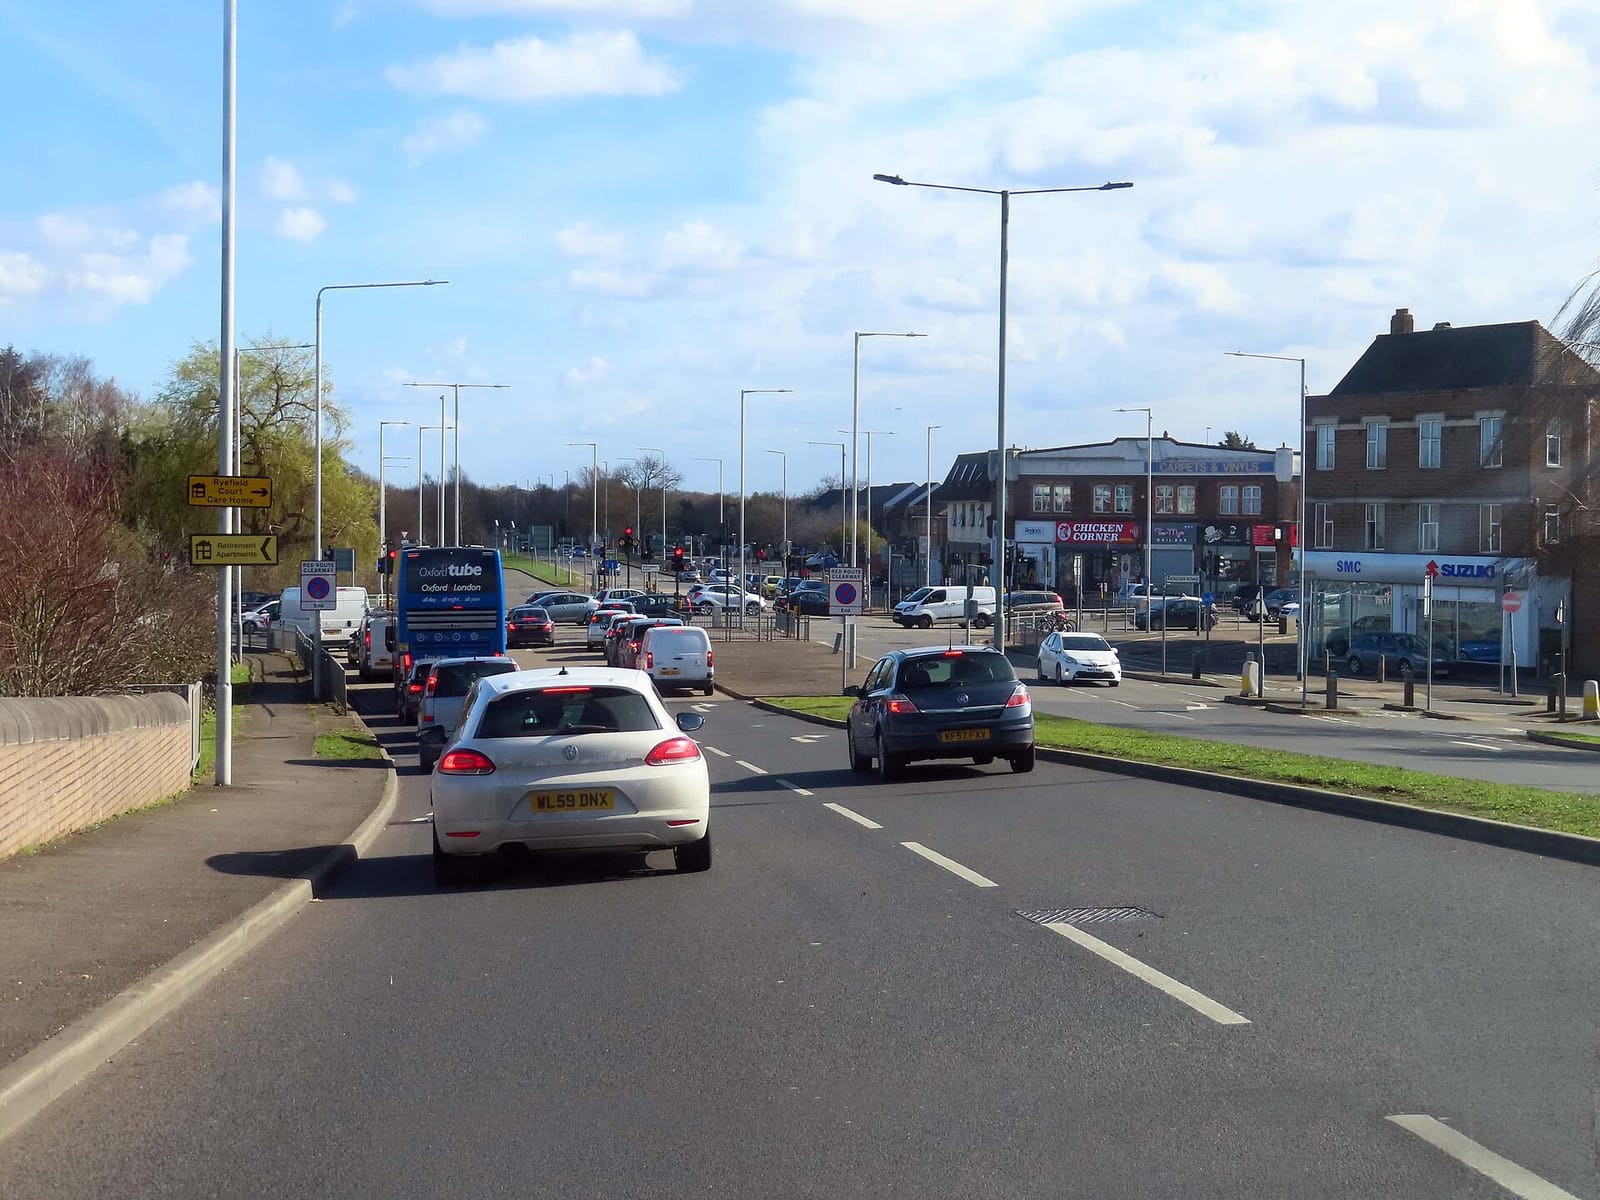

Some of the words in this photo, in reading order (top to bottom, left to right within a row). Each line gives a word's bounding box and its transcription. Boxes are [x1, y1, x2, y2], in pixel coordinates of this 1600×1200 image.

[1160, 462, 1206, 472] CARPETS
[1210, 463, 1218, 472] &
[1223, 462, 1259, 472] VINYLS
[213, 479, 248, 488] Ryefield
[1073, 523, 1124, 532] CHICKEN
[1073, 532, 1119, 542] CORNER
[419, 563, 447, 577] Oxford
[448, 563, 483, 577] tube
[1336, 560, 1361, 573] SMC
[1441, 564, 1496, 578] SUZUKI
[421, 583, 449, 592] Oxford
[453, 583, 481, 592] London
[944, 731, 967, 741] KF57
[537, 793, 576, 809] WL59
[580, 792, 609, 807] DNX
